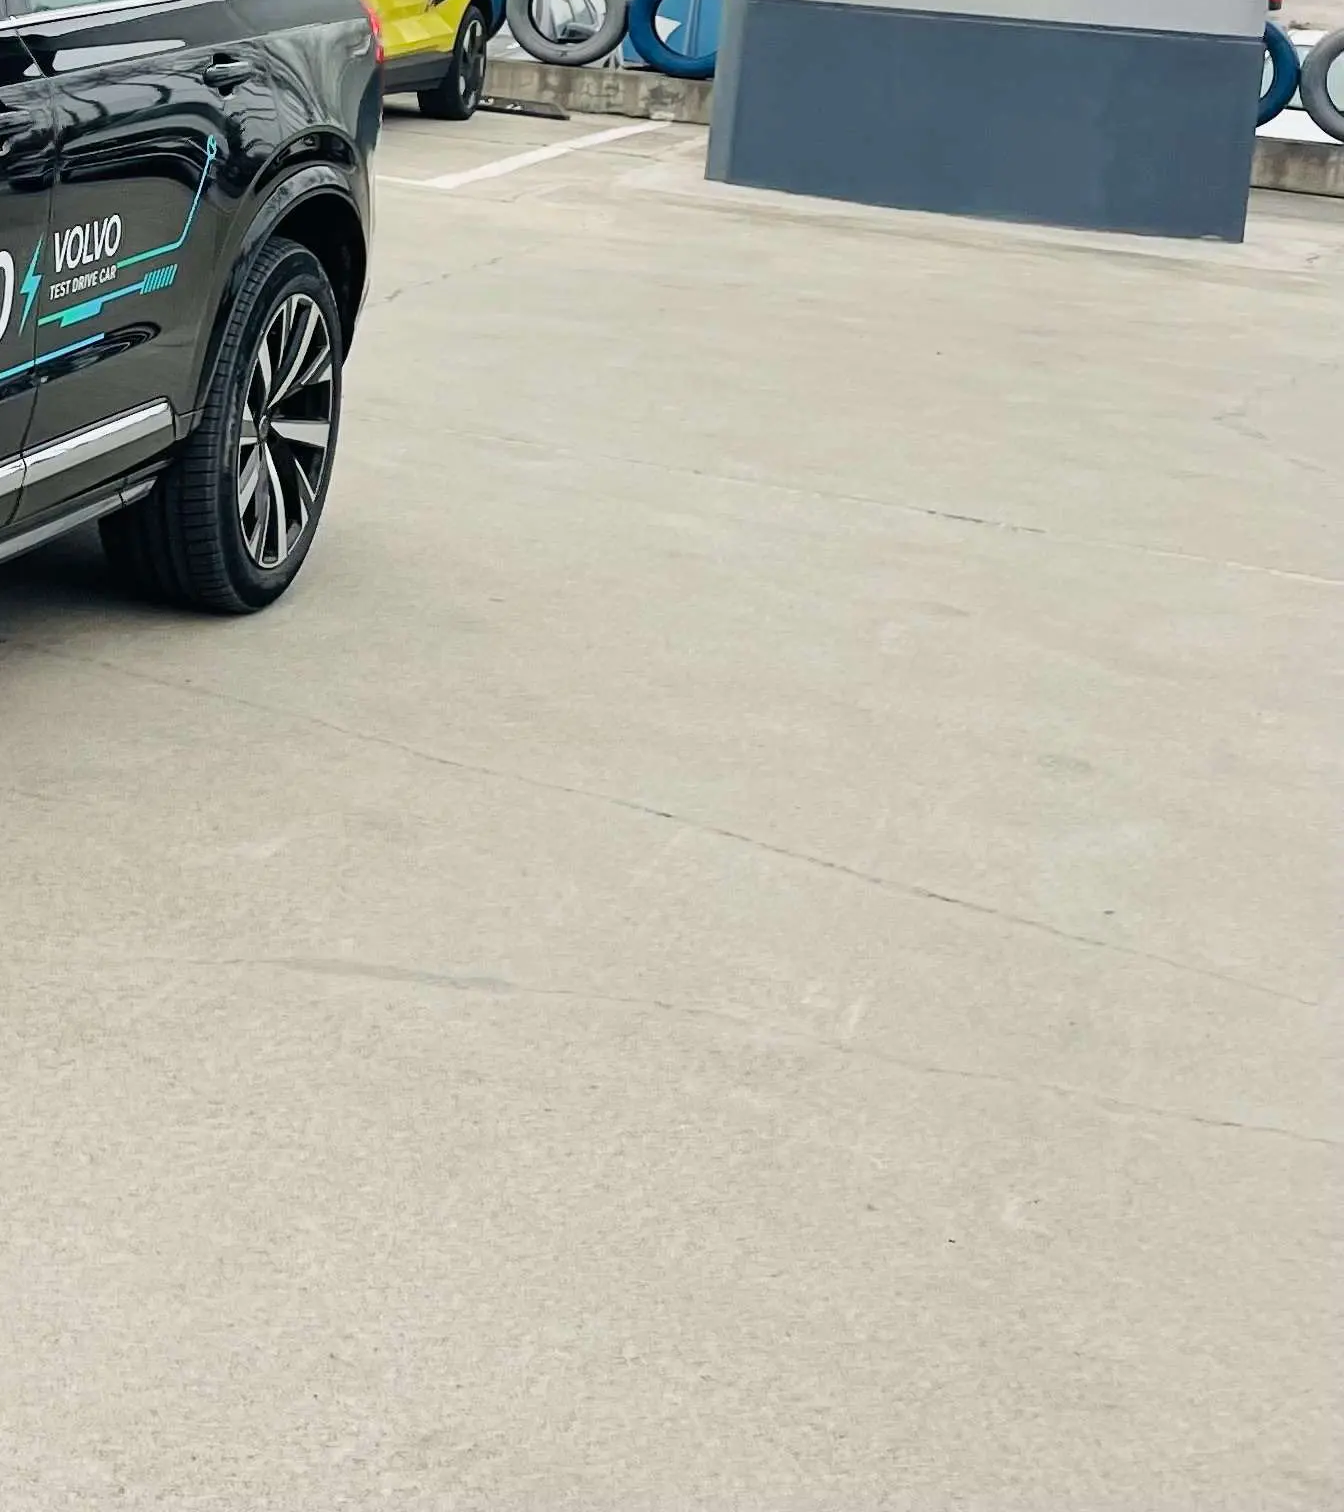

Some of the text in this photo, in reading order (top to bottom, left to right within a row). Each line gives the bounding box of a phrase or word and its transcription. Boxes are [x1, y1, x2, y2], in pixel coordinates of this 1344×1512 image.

[54, 214, 122, 273] VOLVO
[49, 264, 117, 301] TEST DRIVE CAR
